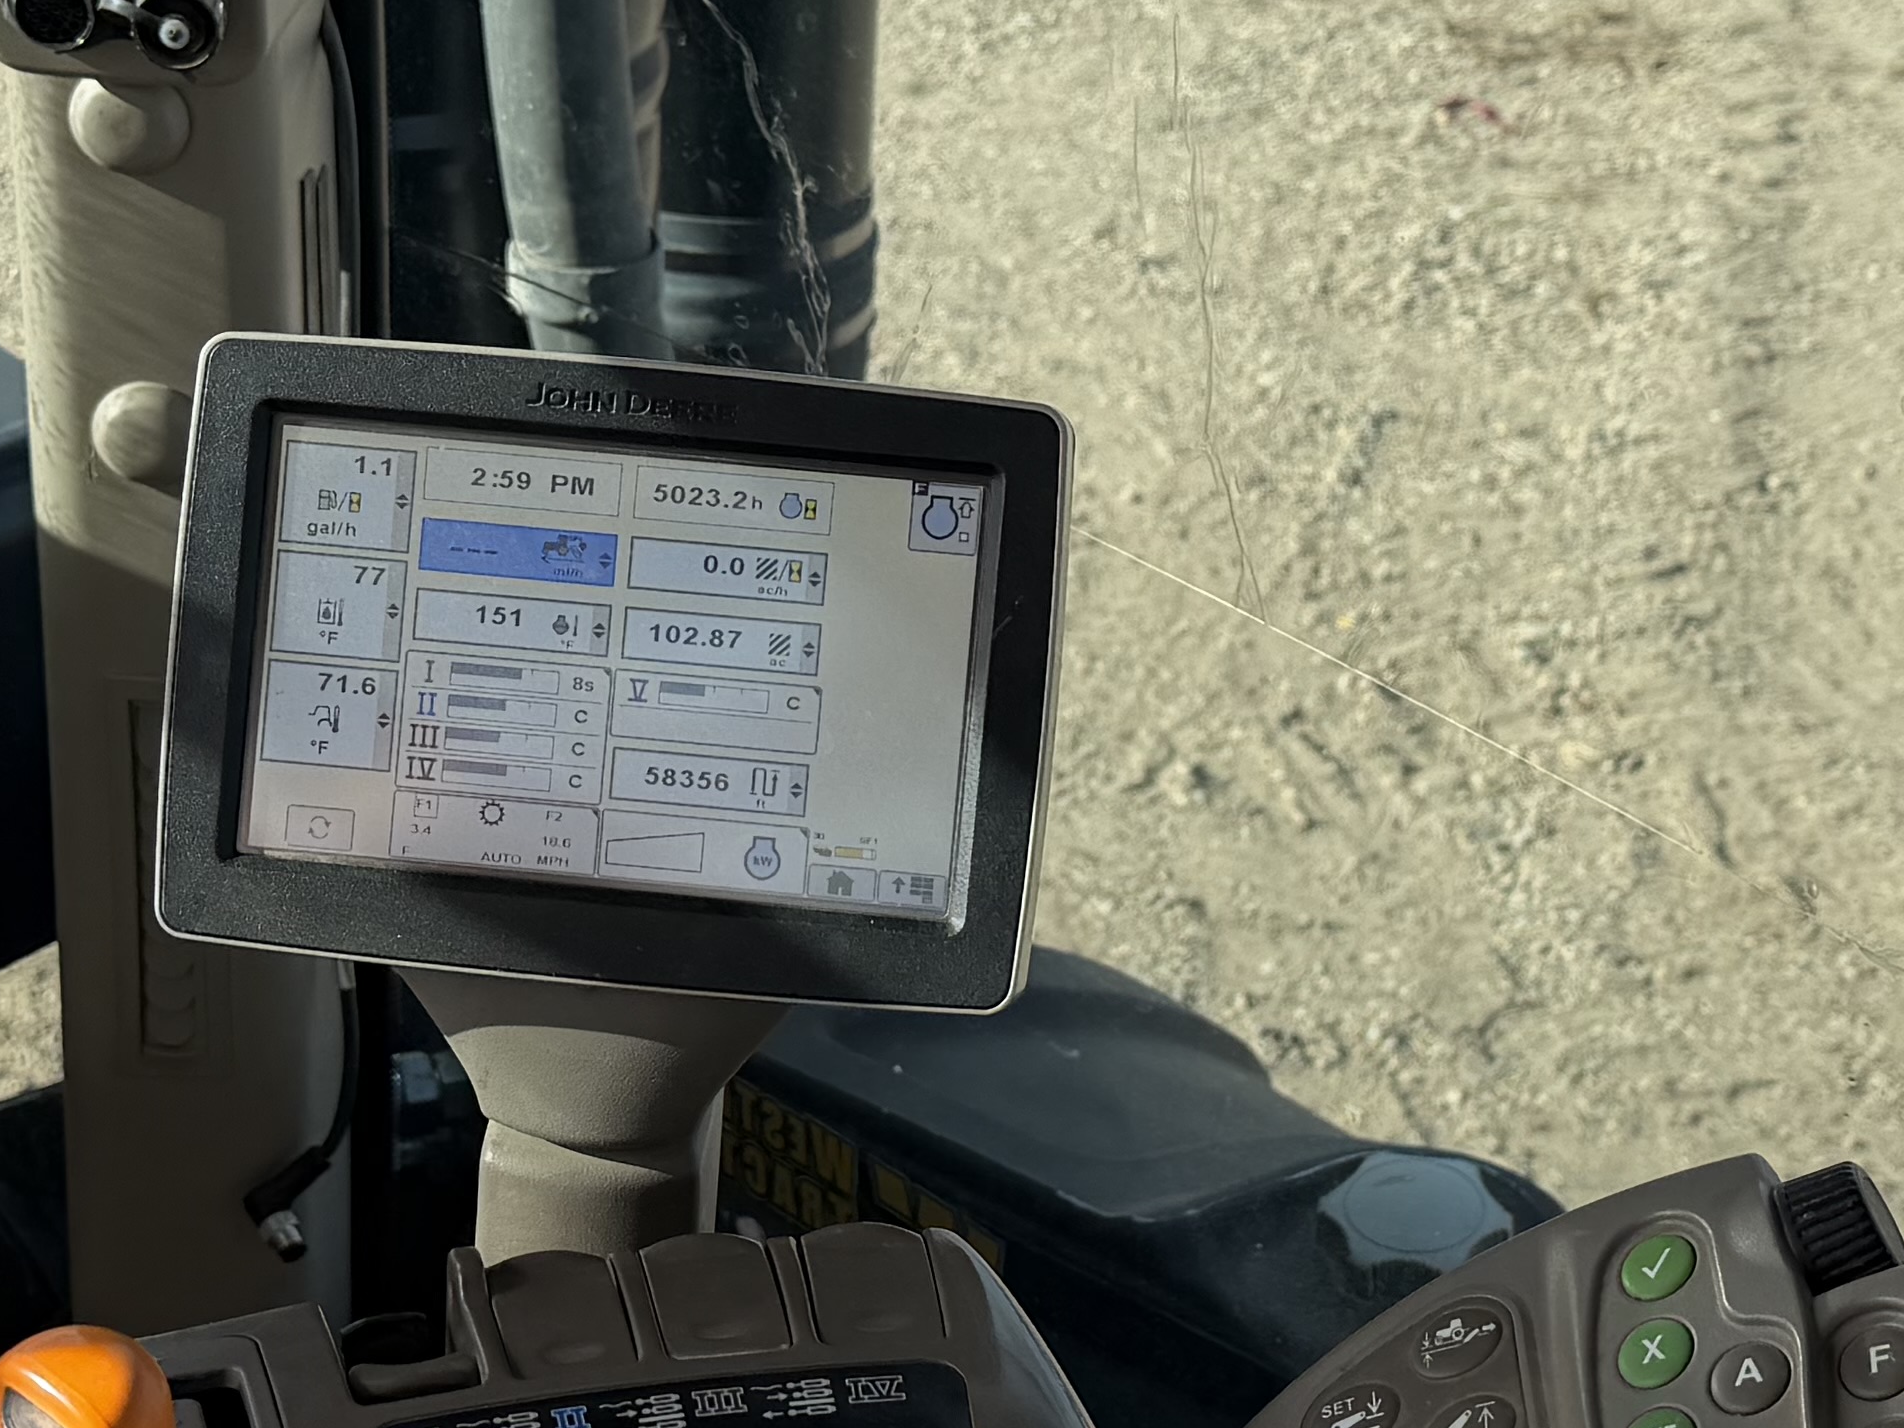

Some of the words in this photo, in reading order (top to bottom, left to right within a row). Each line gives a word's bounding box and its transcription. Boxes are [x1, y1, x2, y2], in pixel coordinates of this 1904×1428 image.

[527, 381, 617, 415] JOHN
[354, 455, 393, 477] 1.1
[470, 466, 532, 491] 2:59
[549, 474, 596, 497] PM
[306, 521, 357, 538] gal/h
[353, 564, 387, 586] 77
[702, 554, 745, 577] 0.0
[475, 604, 522, 628] 151
[649, 622, 743, 650] 102.87
[317, 672, 377, 696] 71.6
[785, 695, 801, 711] C
[574, 709, 589, 724] C
[407, 723, 441, 749] III
[571, 741, 586, 757] C
[404, 755, 438, 781] IV
[567, 773, 583, 789] C
[643, 765, 730, 793] 58356
[480, 850, 522, 865] AUTO
[1867, 1343, 1892, 1374] F
[1734, 1357, 1764, 1387] A
[1320, 1396, 1356, 1420] SET
